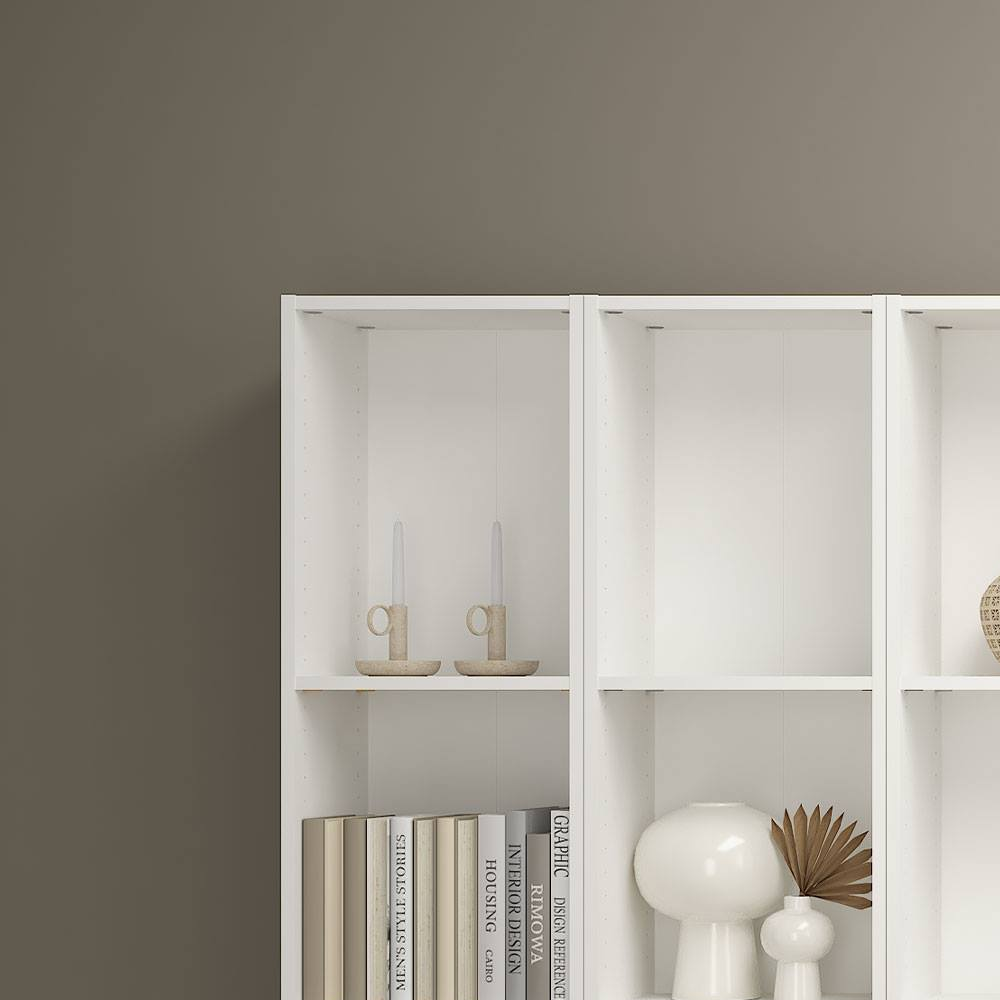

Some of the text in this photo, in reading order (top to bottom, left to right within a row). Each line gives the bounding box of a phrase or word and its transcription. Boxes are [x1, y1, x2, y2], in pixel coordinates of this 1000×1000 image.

[553, 814, 569, 878] GRAPHIC
[396, 834, 407, 991] MEN'S STYLE STORIES
[484, 859, 497, 983] HOUSING CAIRO
[507, 843, 522, 975] INTERIOR DESIGN
[530, 884, 544, 966] RIMOWA
[553, 897, 567, 934] DISIGN
